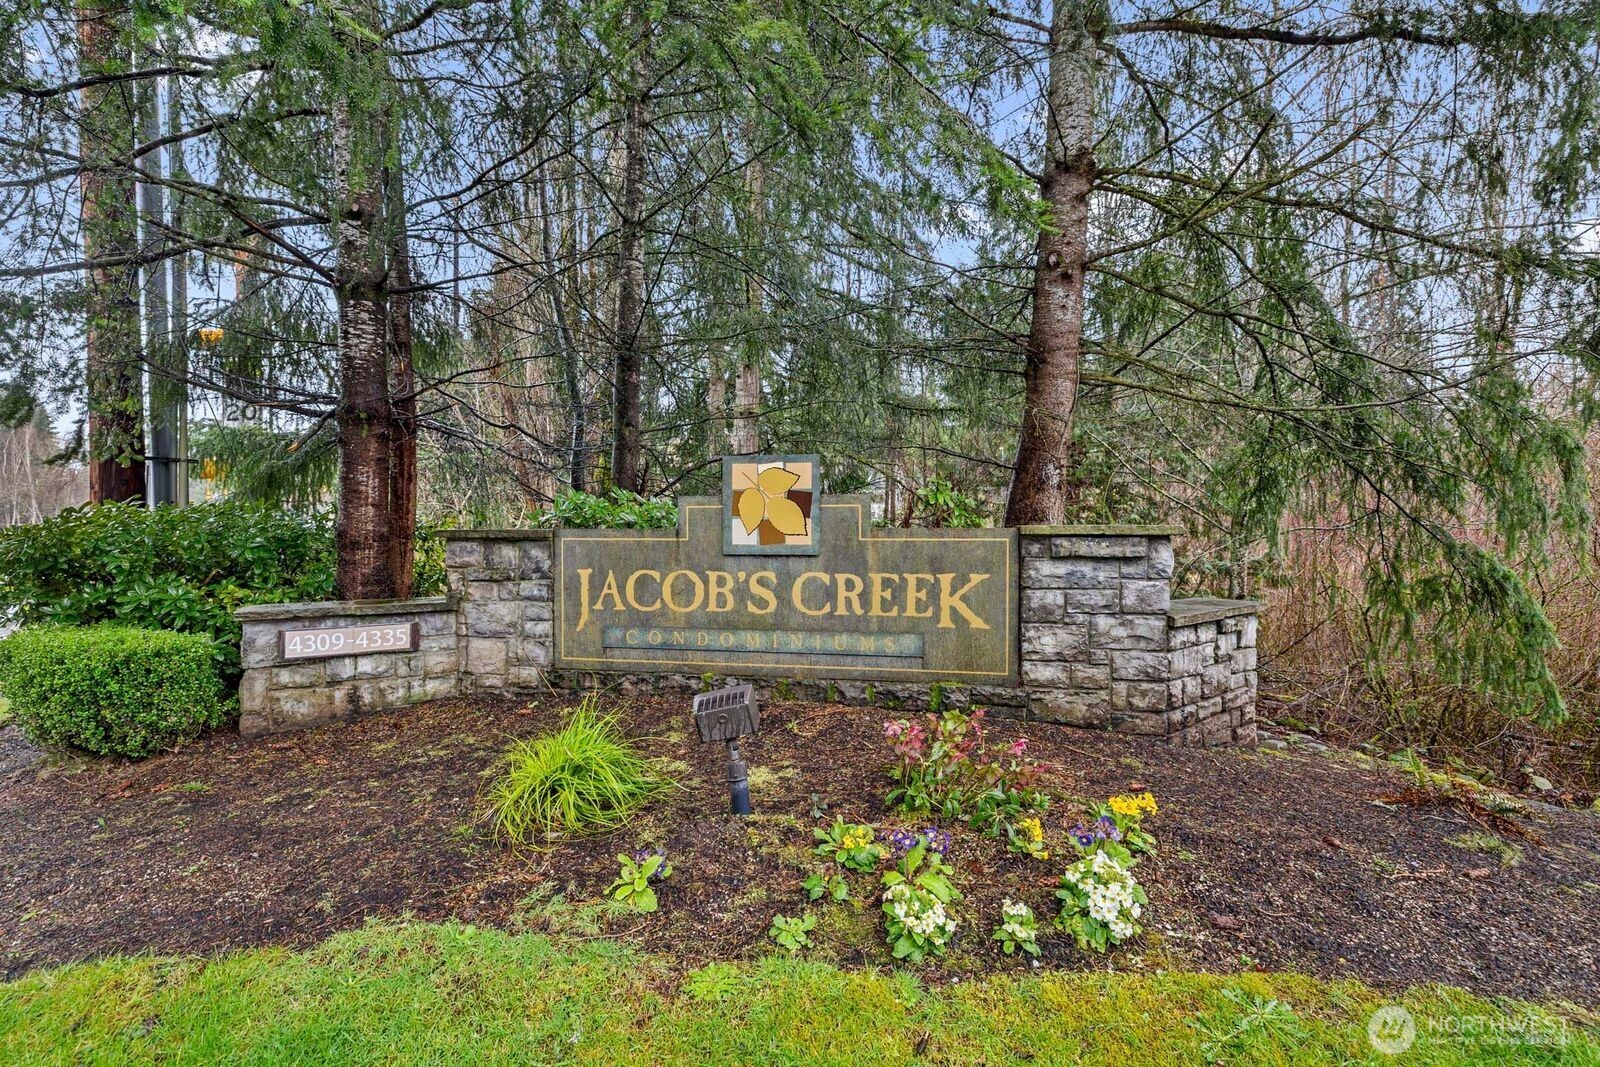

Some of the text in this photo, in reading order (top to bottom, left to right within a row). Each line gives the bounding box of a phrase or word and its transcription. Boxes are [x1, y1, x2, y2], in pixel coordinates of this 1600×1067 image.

[576, 568, 990, 632] JACOB'S CREEK
[288, 628, 407, 653] 4309-4335
[625, 629, 896, 652] CONDOMINIUMS
